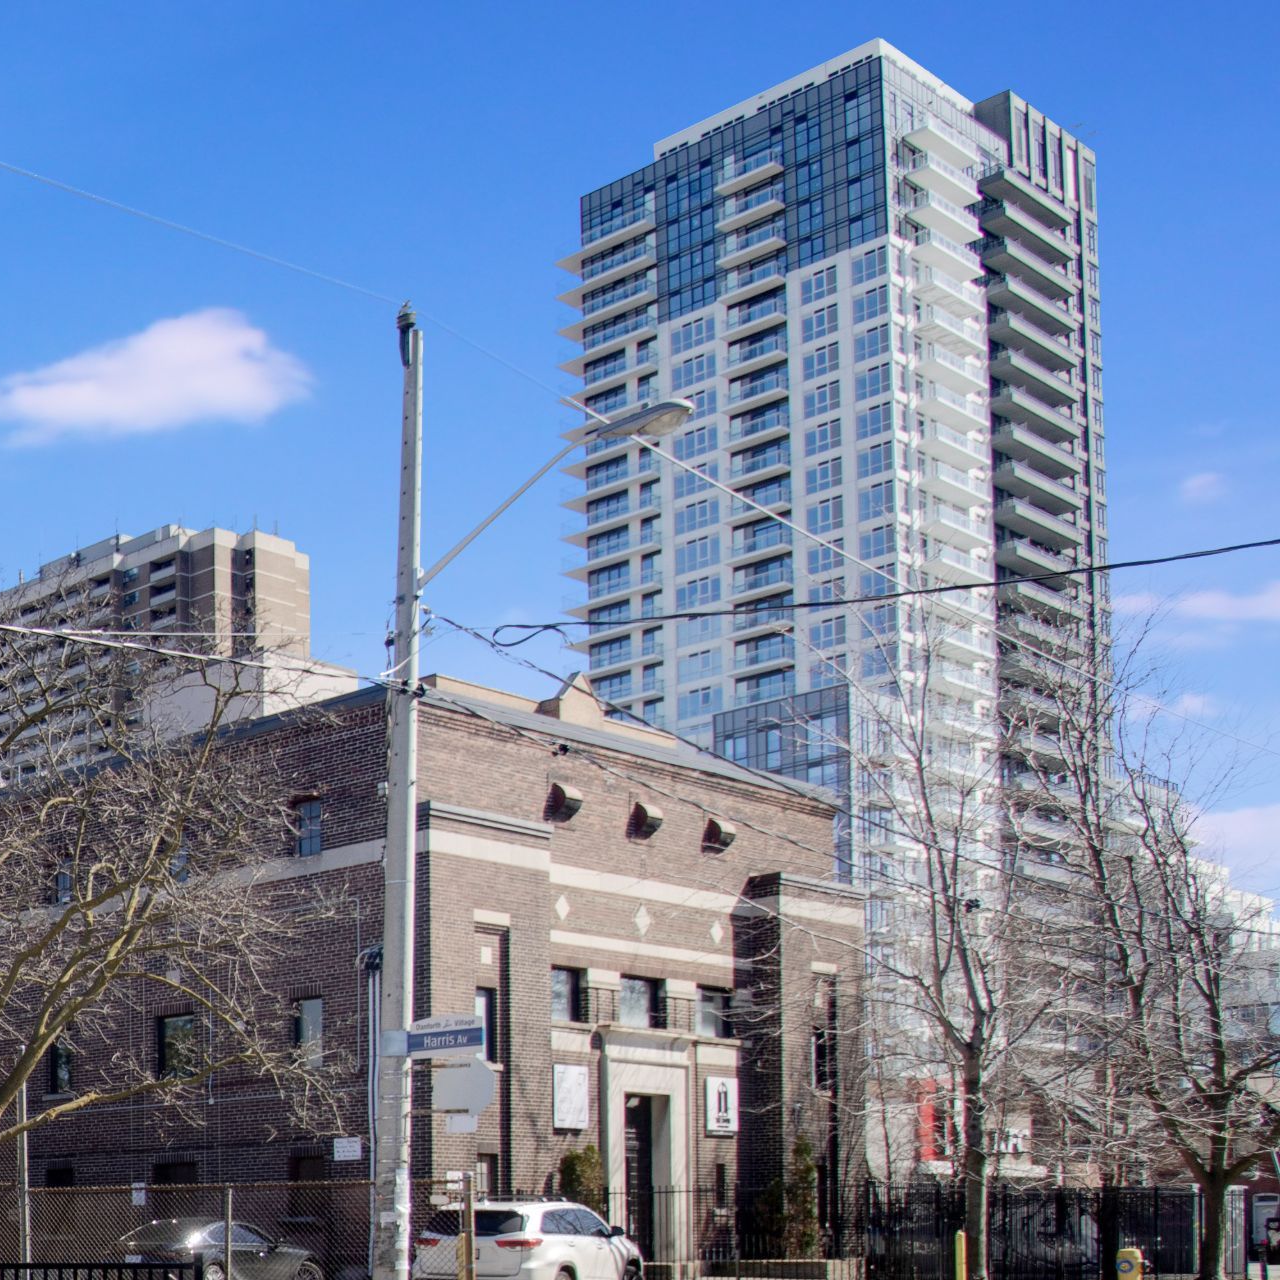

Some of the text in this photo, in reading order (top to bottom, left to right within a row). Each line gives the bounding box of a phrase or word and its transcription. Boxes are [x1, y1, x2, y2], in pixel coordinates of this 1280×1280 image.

[454, 1019, 475, 1027] Village
[423, 1033, 468, 1048] Harris Av
